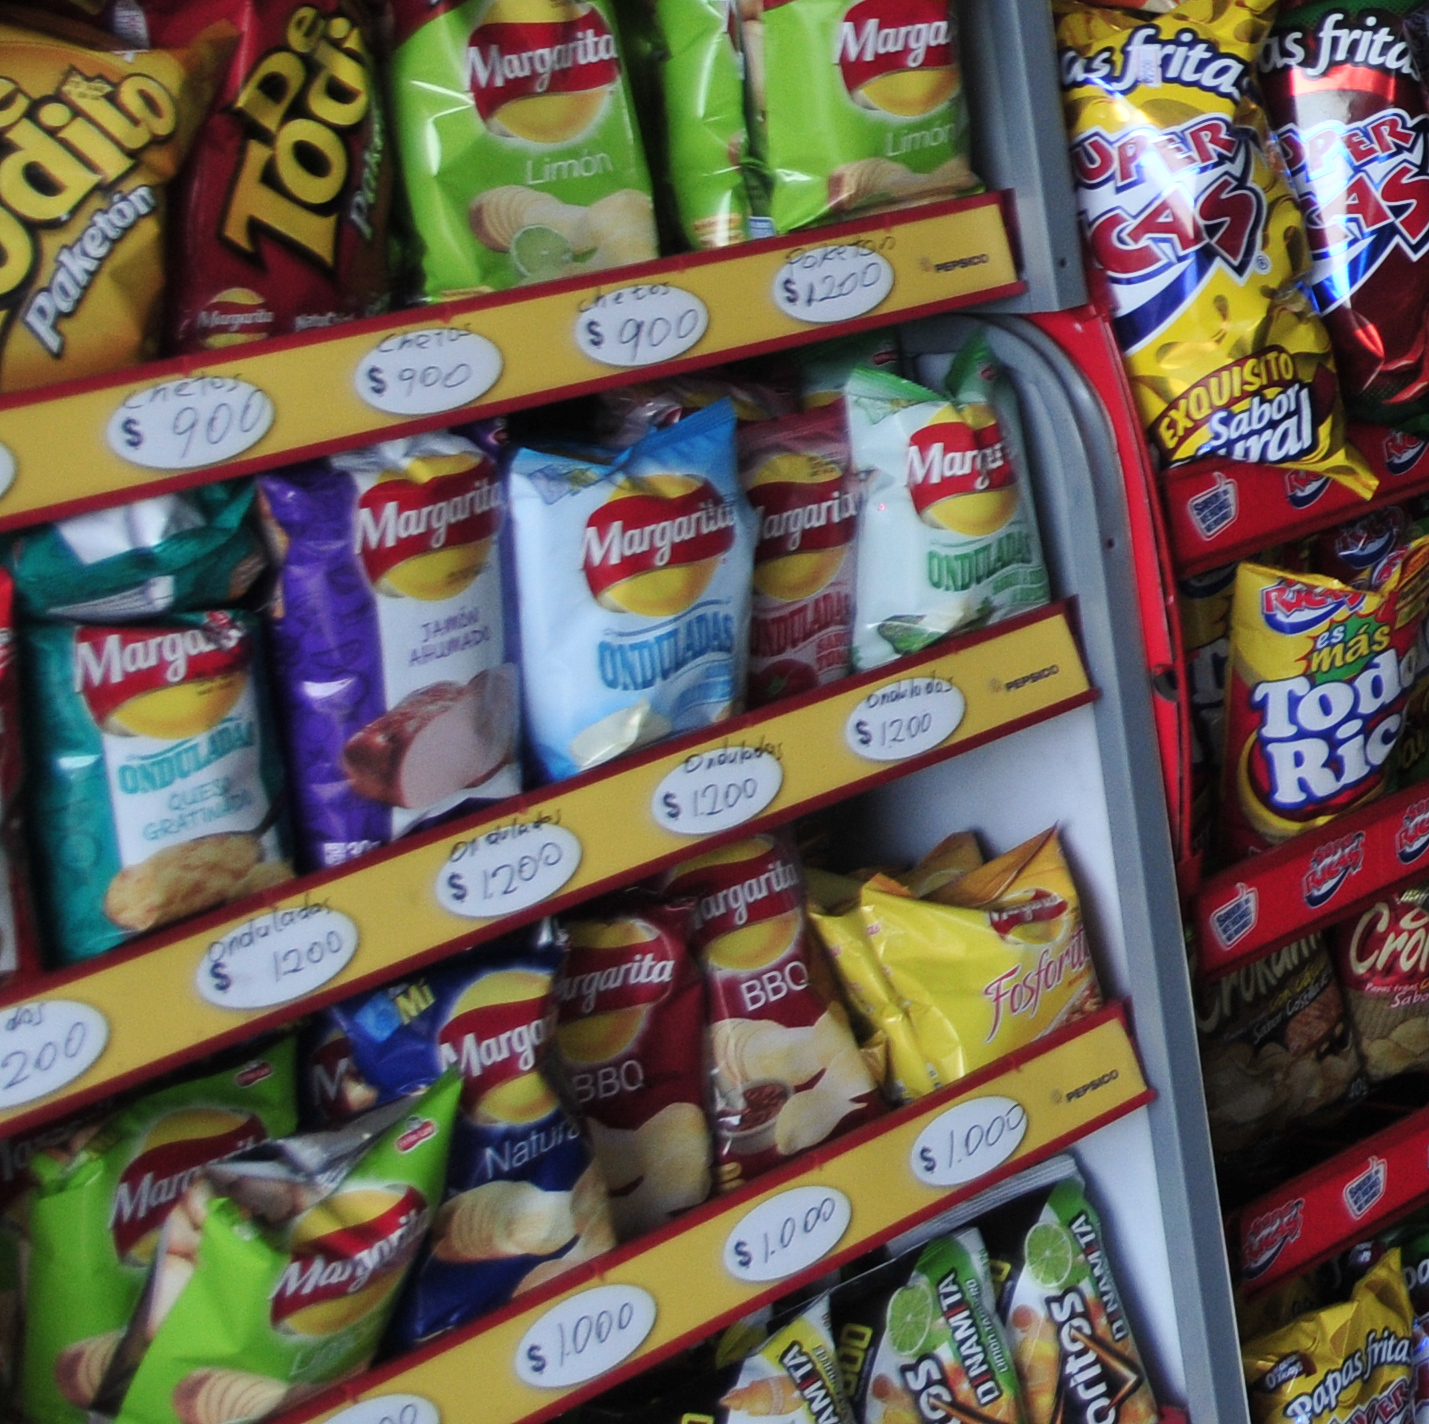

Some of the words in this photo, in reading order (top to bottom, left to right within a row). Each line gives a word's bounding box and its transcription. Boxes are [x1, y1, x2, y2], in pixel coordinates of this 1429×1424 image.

[464, 23, 621, 93] Margarita
[834, 13, 952, 82] Marga
[1306, 12, 1418, 76] frita
[526, 148, 612, 187] Limón
[1072, 117, 1238, 185] UPER
[1089, 176, 1262, 276] CAS
[23, 183, 158, 357] Paketón
[620, 309, 700, 359] 900
[398, 362, 474, 399] 900
[1158, 353, 1297, 452] EXQUISITO
[1209, 380, 1300, 443] Sabor
[172, 388, 266, 458] 900
[355, 476, 503, 555] Margarita
[582, 490, 736, 568] Margarita
[598, 611, 736, 695] ONDULADAS
[1310, 619, 1392, 675] más
[1315, 626, 1345, 649] es
[1254, 644, 1401, 742] Tod
[738, 961, 810, 1014] BBQ
[438, 1012, 549, 1080] Marga
[570, 1059, 646, 1107] BBQ
[483, 1118, 584, 1178] Natura
[1047, 1287, 1114, 1424] oritos
[1286, 1353, 1361, 1421] Papas
